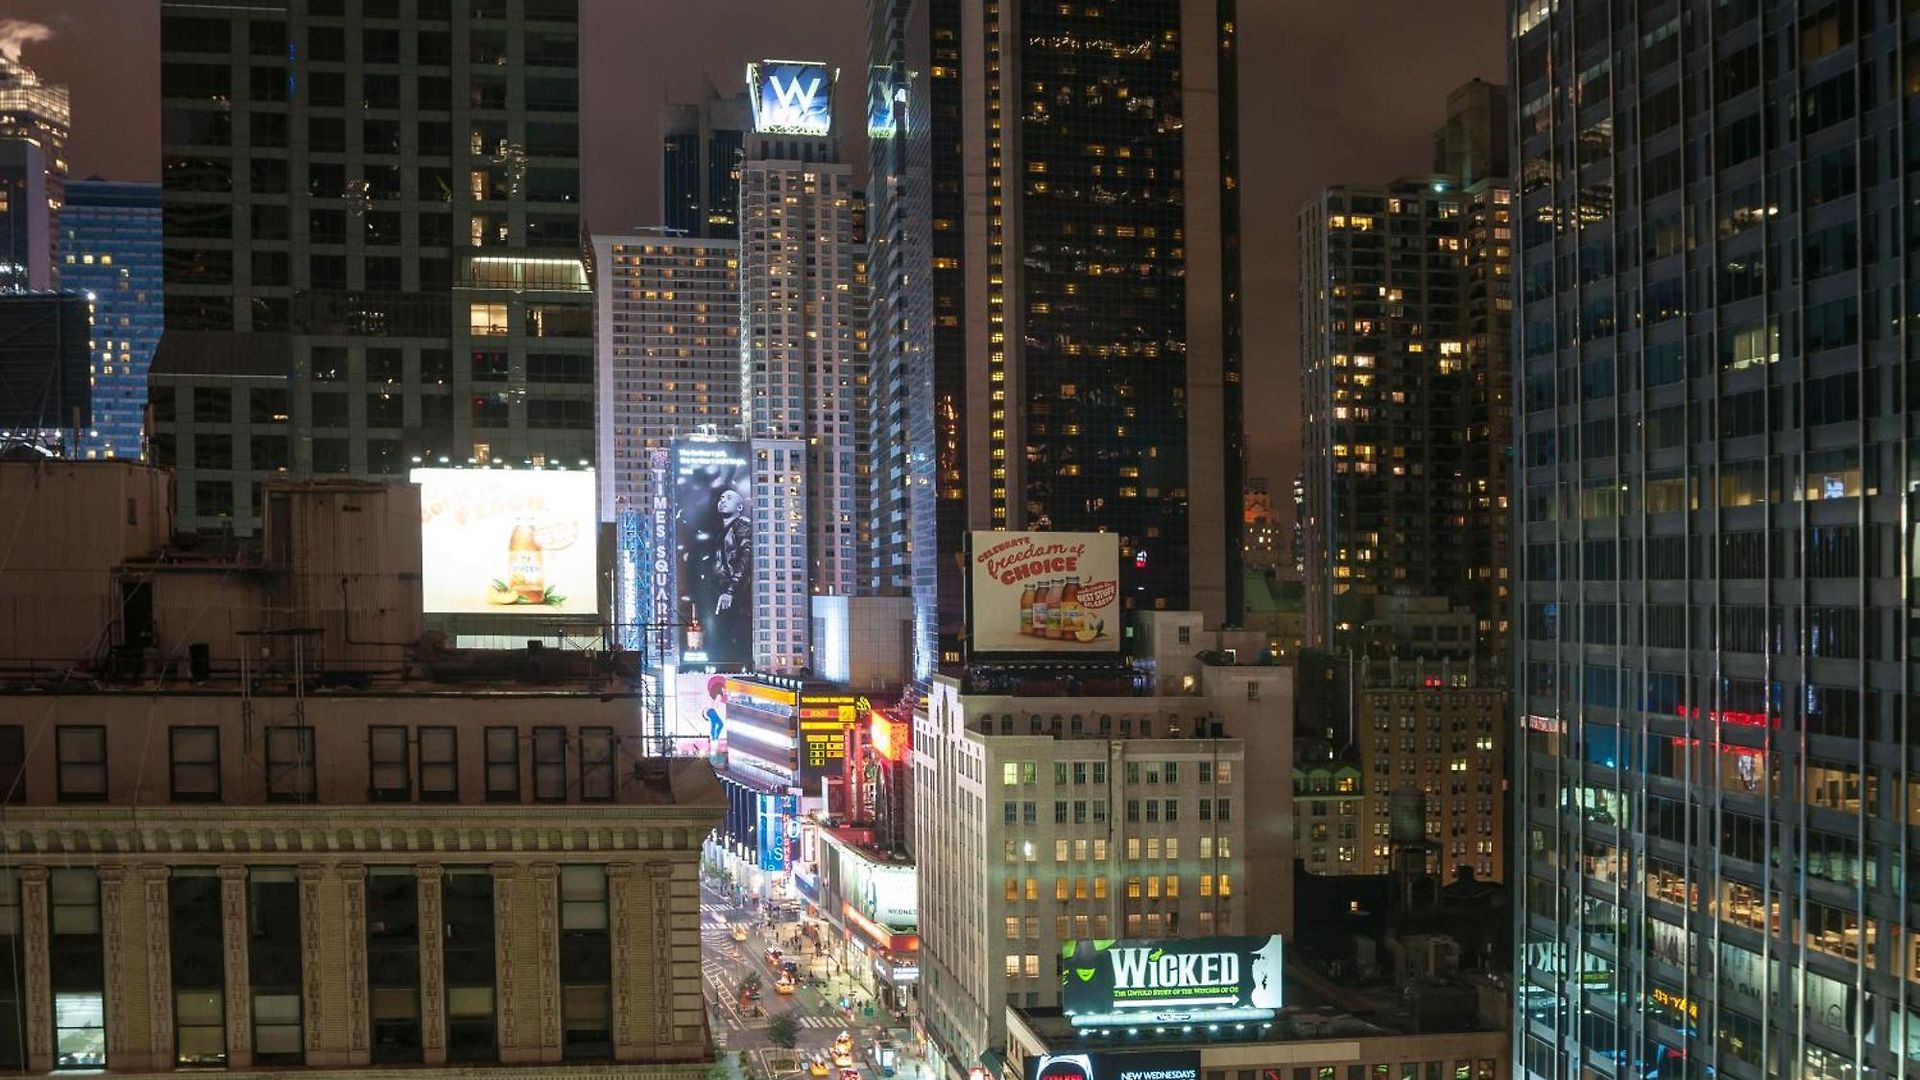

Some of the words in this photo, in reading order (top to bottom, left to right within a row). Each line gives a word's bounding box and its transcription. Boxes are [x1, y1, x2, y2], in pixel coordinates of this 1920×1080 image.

[769, 75, 821, 114] W
[653, 468, 669, 538] TIMES
[977, 536, 1031, 563] CELEBRATE
[987, 544, 1067, 580] freedom
[1069, 543, 1086, 558] of
[1000, 557, 1078, 586] CHOICE
[653, 548, 670, 629] SQUARE
[1127, 988, 1152, 997] UNTOLD
[1173, 988, 1181, 996] OF
[1121, 1071, 1142, 1080] NEW
[1143, 1070, 1196, 1079] WEDNESDAYS
